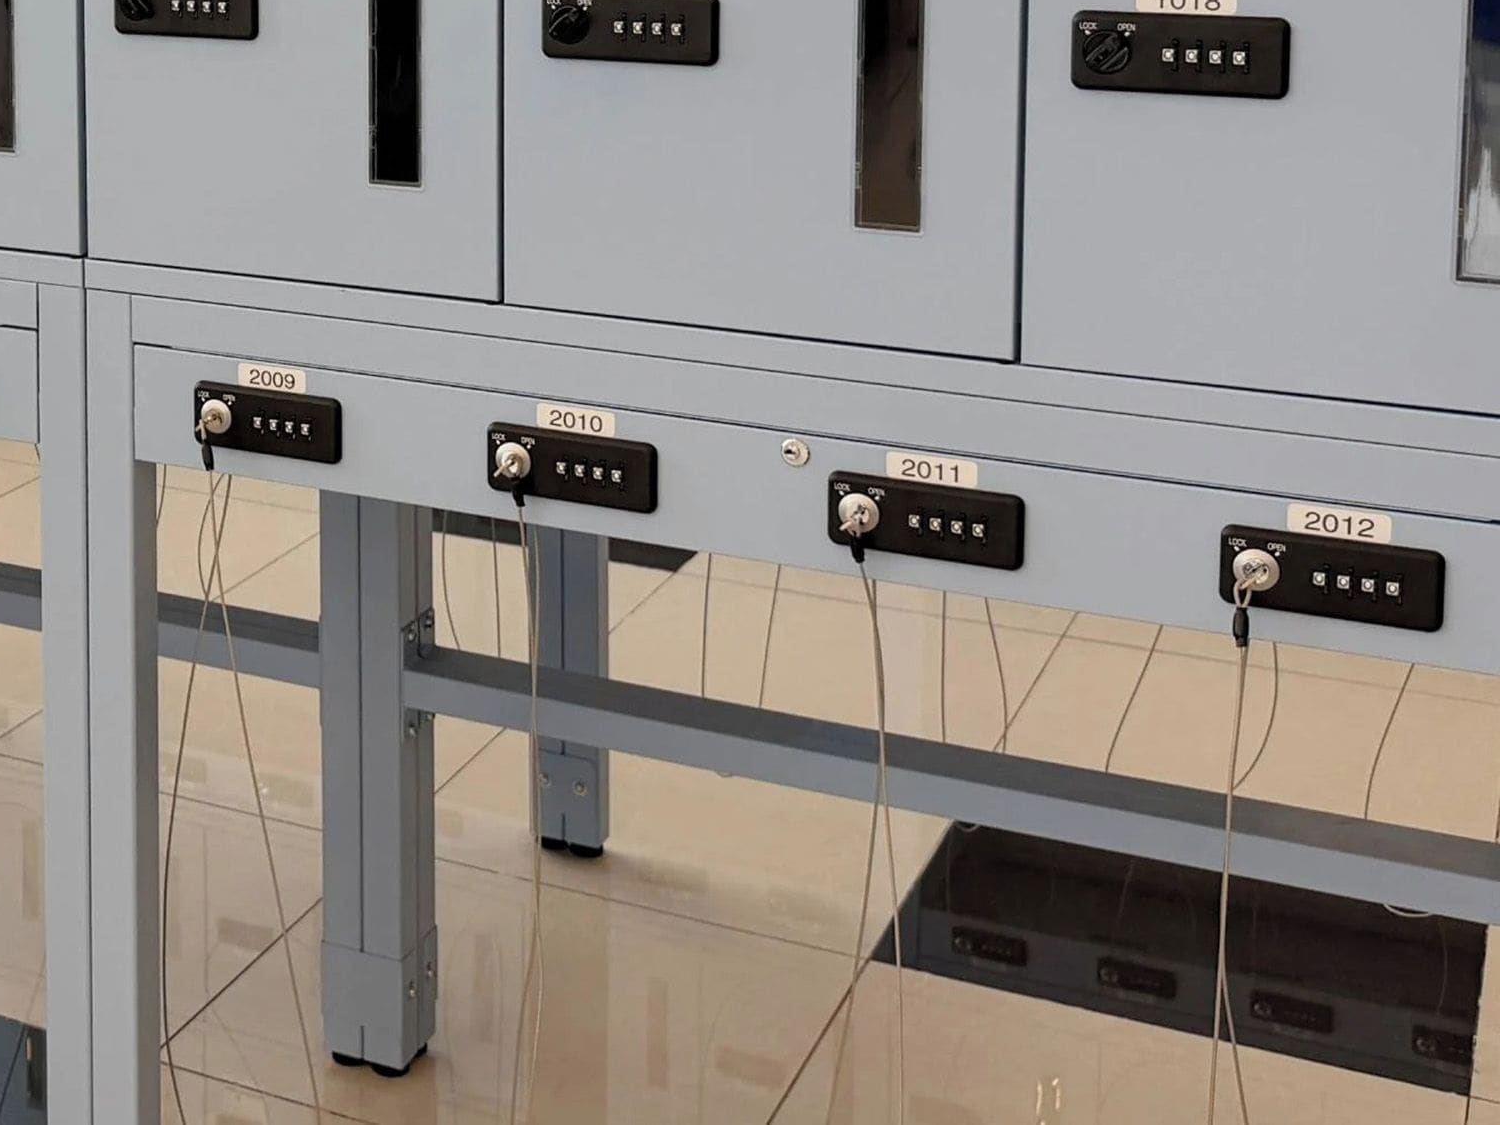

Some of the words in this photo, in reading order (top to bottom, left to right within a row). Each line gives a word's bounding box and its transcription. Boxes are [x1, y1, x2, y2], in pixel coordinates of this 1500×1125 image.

[249, 369, 295, 389] 2009
[549, 410, 603, 432] 2010
[901, 459, 959, 483] 2011
[1304, 511, 1374, 538] 2012
[1228, 537, 1247, 547] LOCK
[1267, 542, 1286, 552] OPEN
